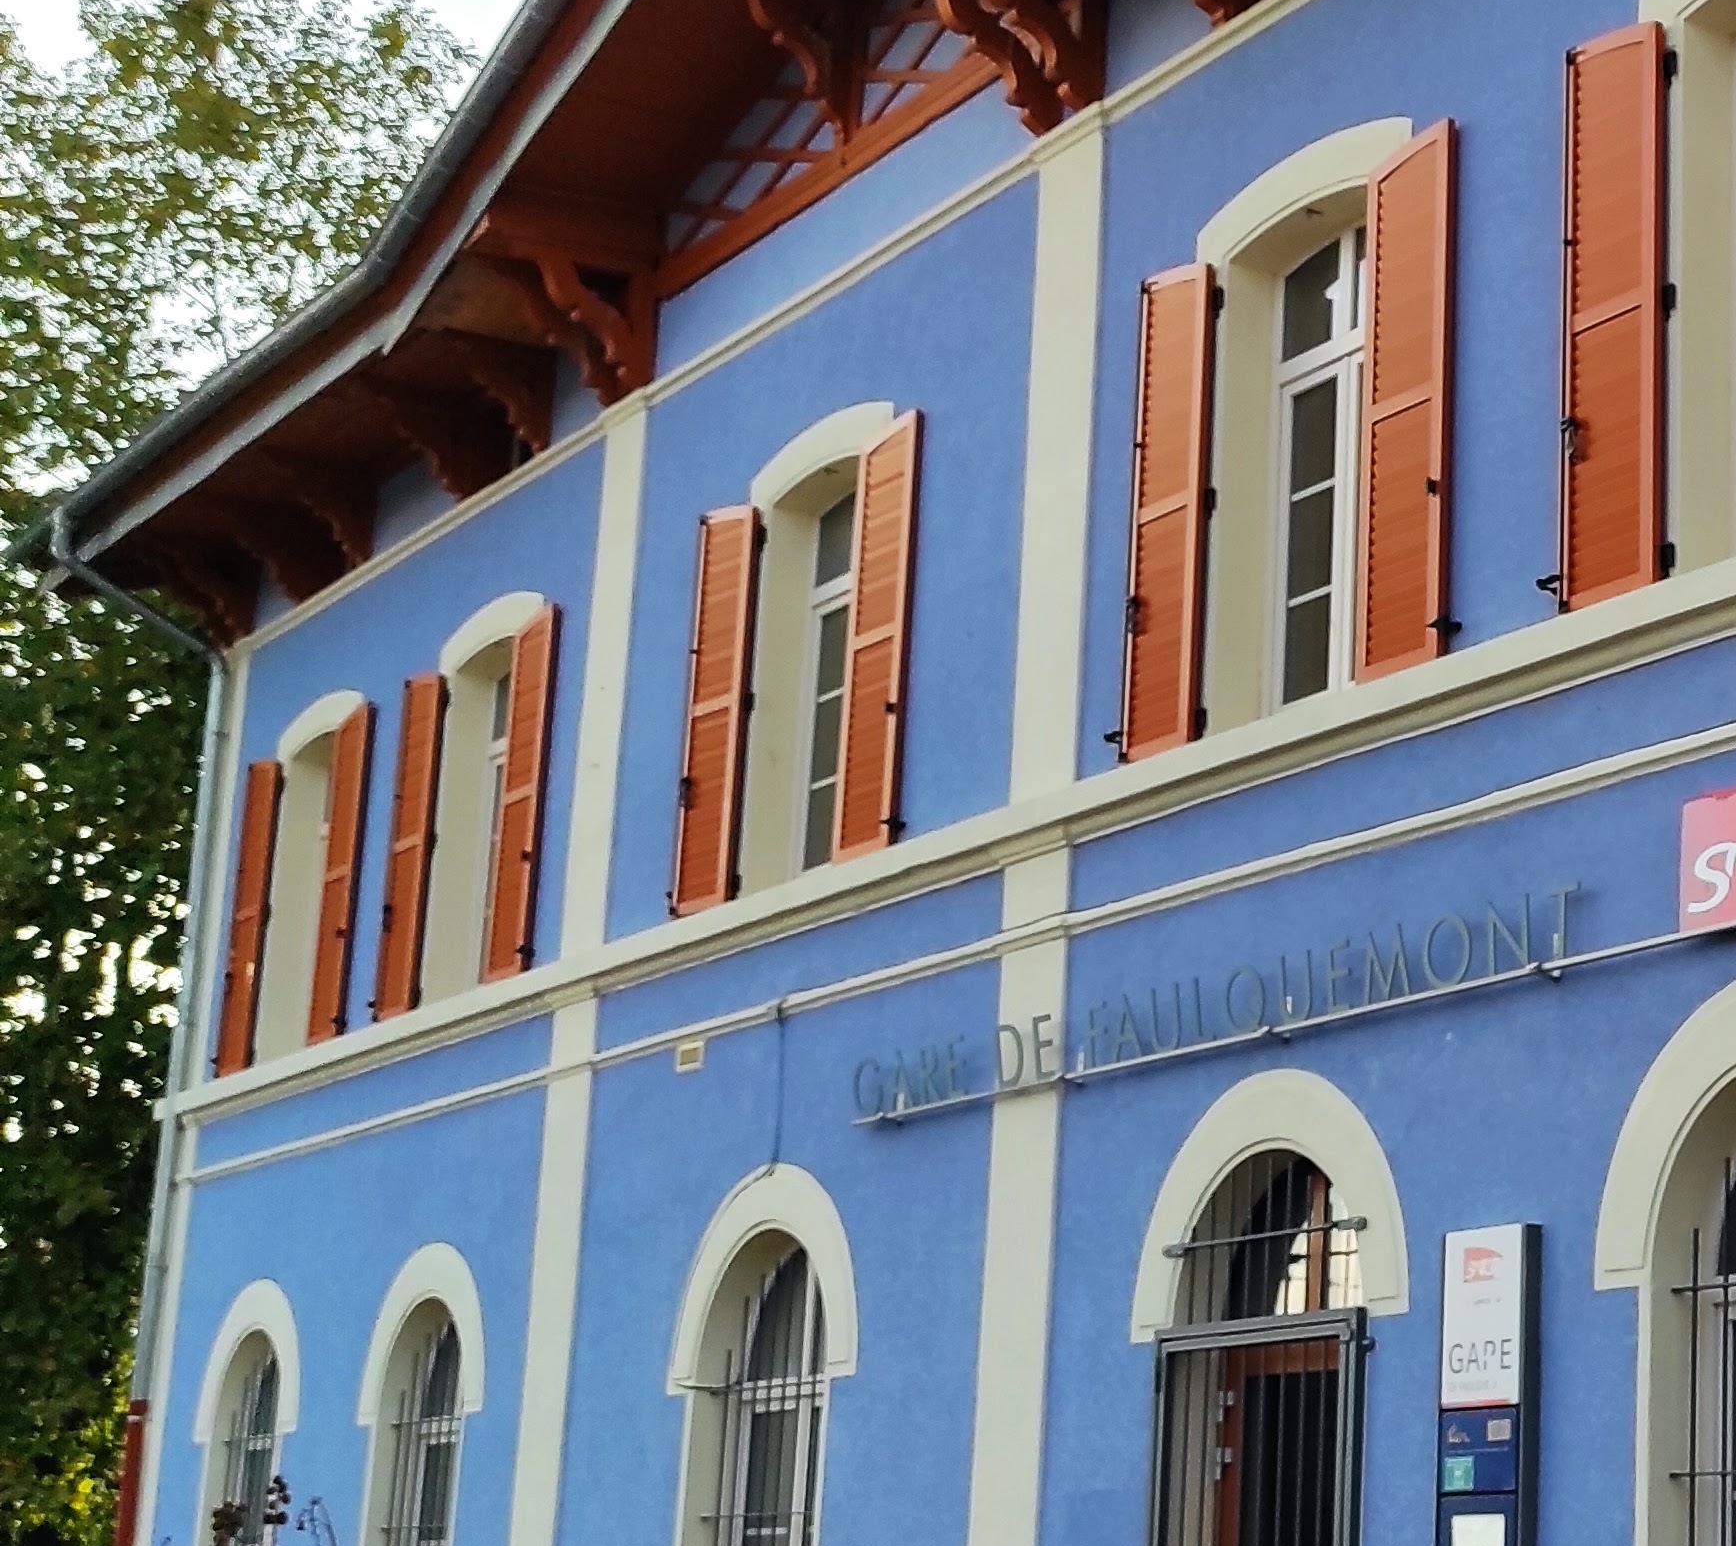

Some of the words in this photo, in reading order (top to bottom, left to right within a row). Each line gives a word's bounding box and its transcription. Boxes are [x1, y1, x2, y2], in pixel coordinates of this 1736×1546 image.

[853, 1033, 967, 1115] GARE
[997, 1013, 1057, 1089] DE
[1083, 880, 1583, 1069] FAULQUEMONT
[1448, 1337, 1513, 1374] GARE
